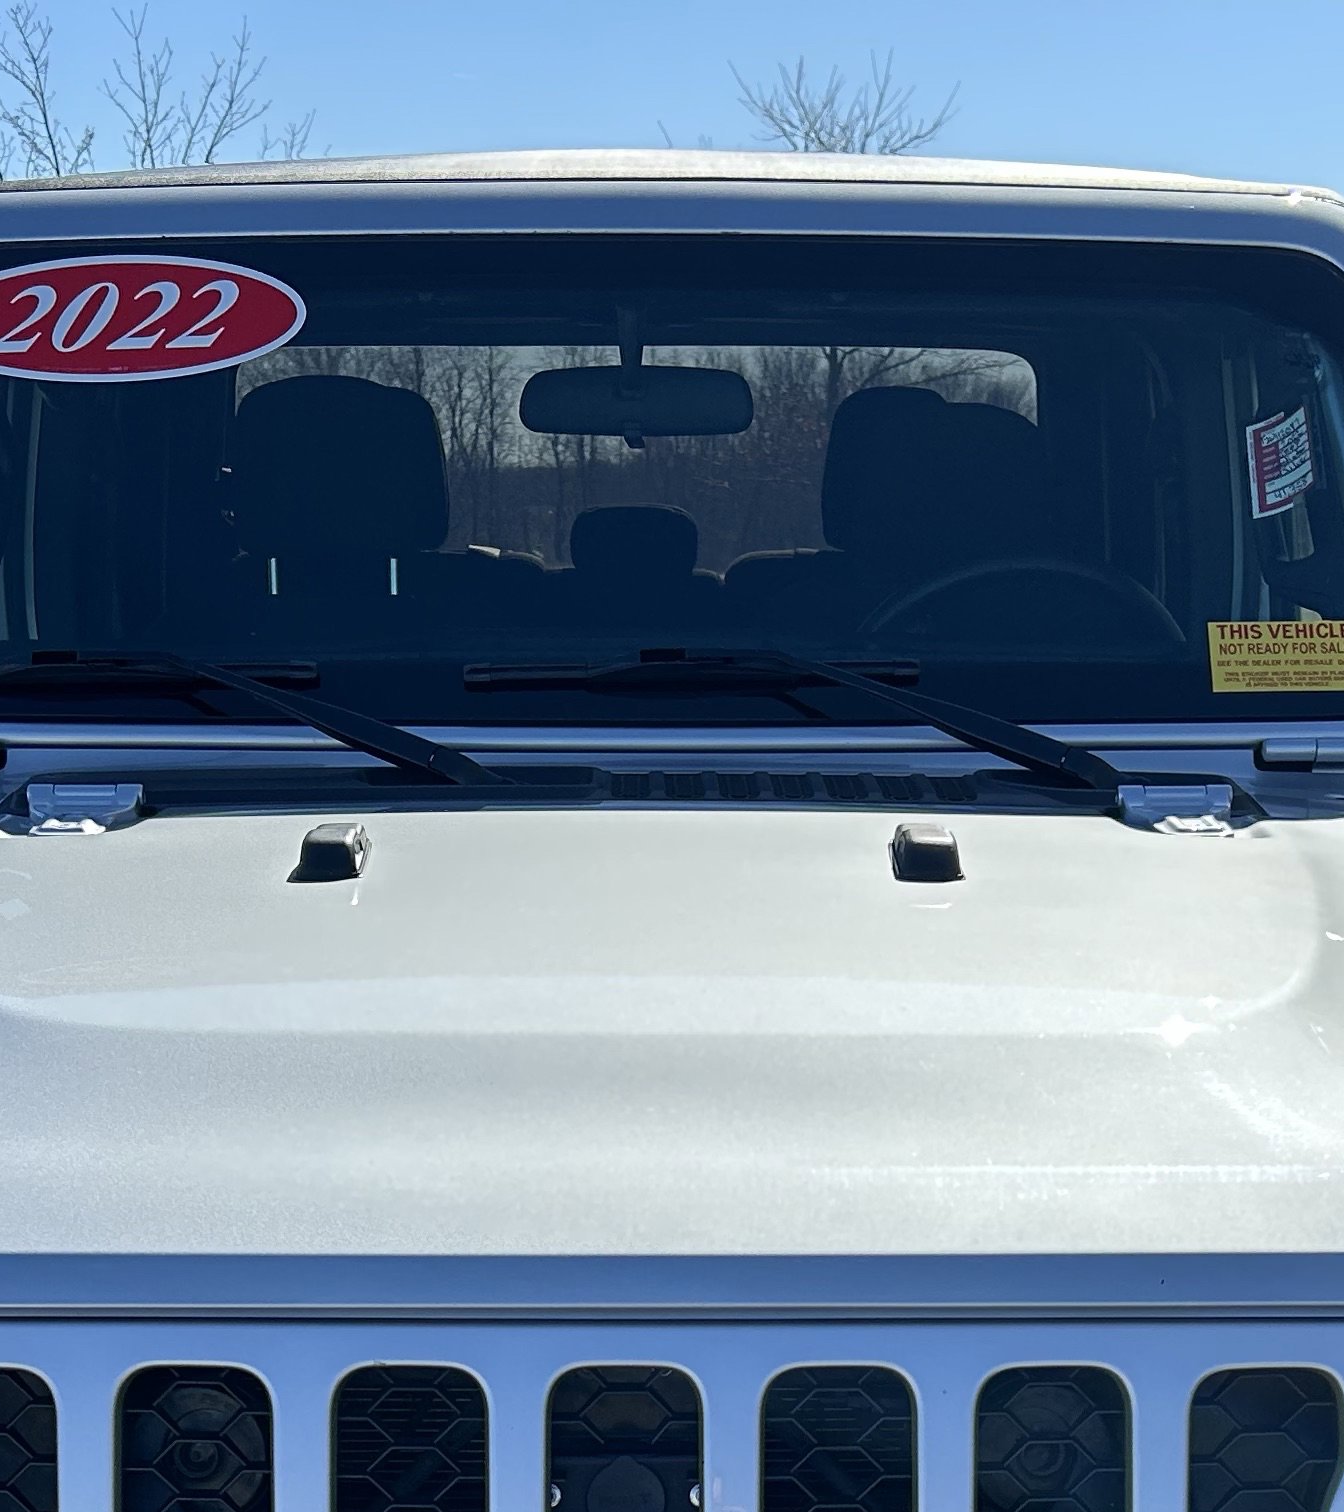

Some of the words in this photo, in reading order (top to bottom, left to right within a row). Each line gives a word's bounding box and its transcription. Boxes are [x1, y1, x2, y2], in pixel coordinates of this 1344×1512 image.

[1216, 623, 1263, 640] THIS
[1219, 643, 1244, 655] NOT
[1248, 642, 1289, 655] READY
[1292, 642, 1317, 655] FOR
